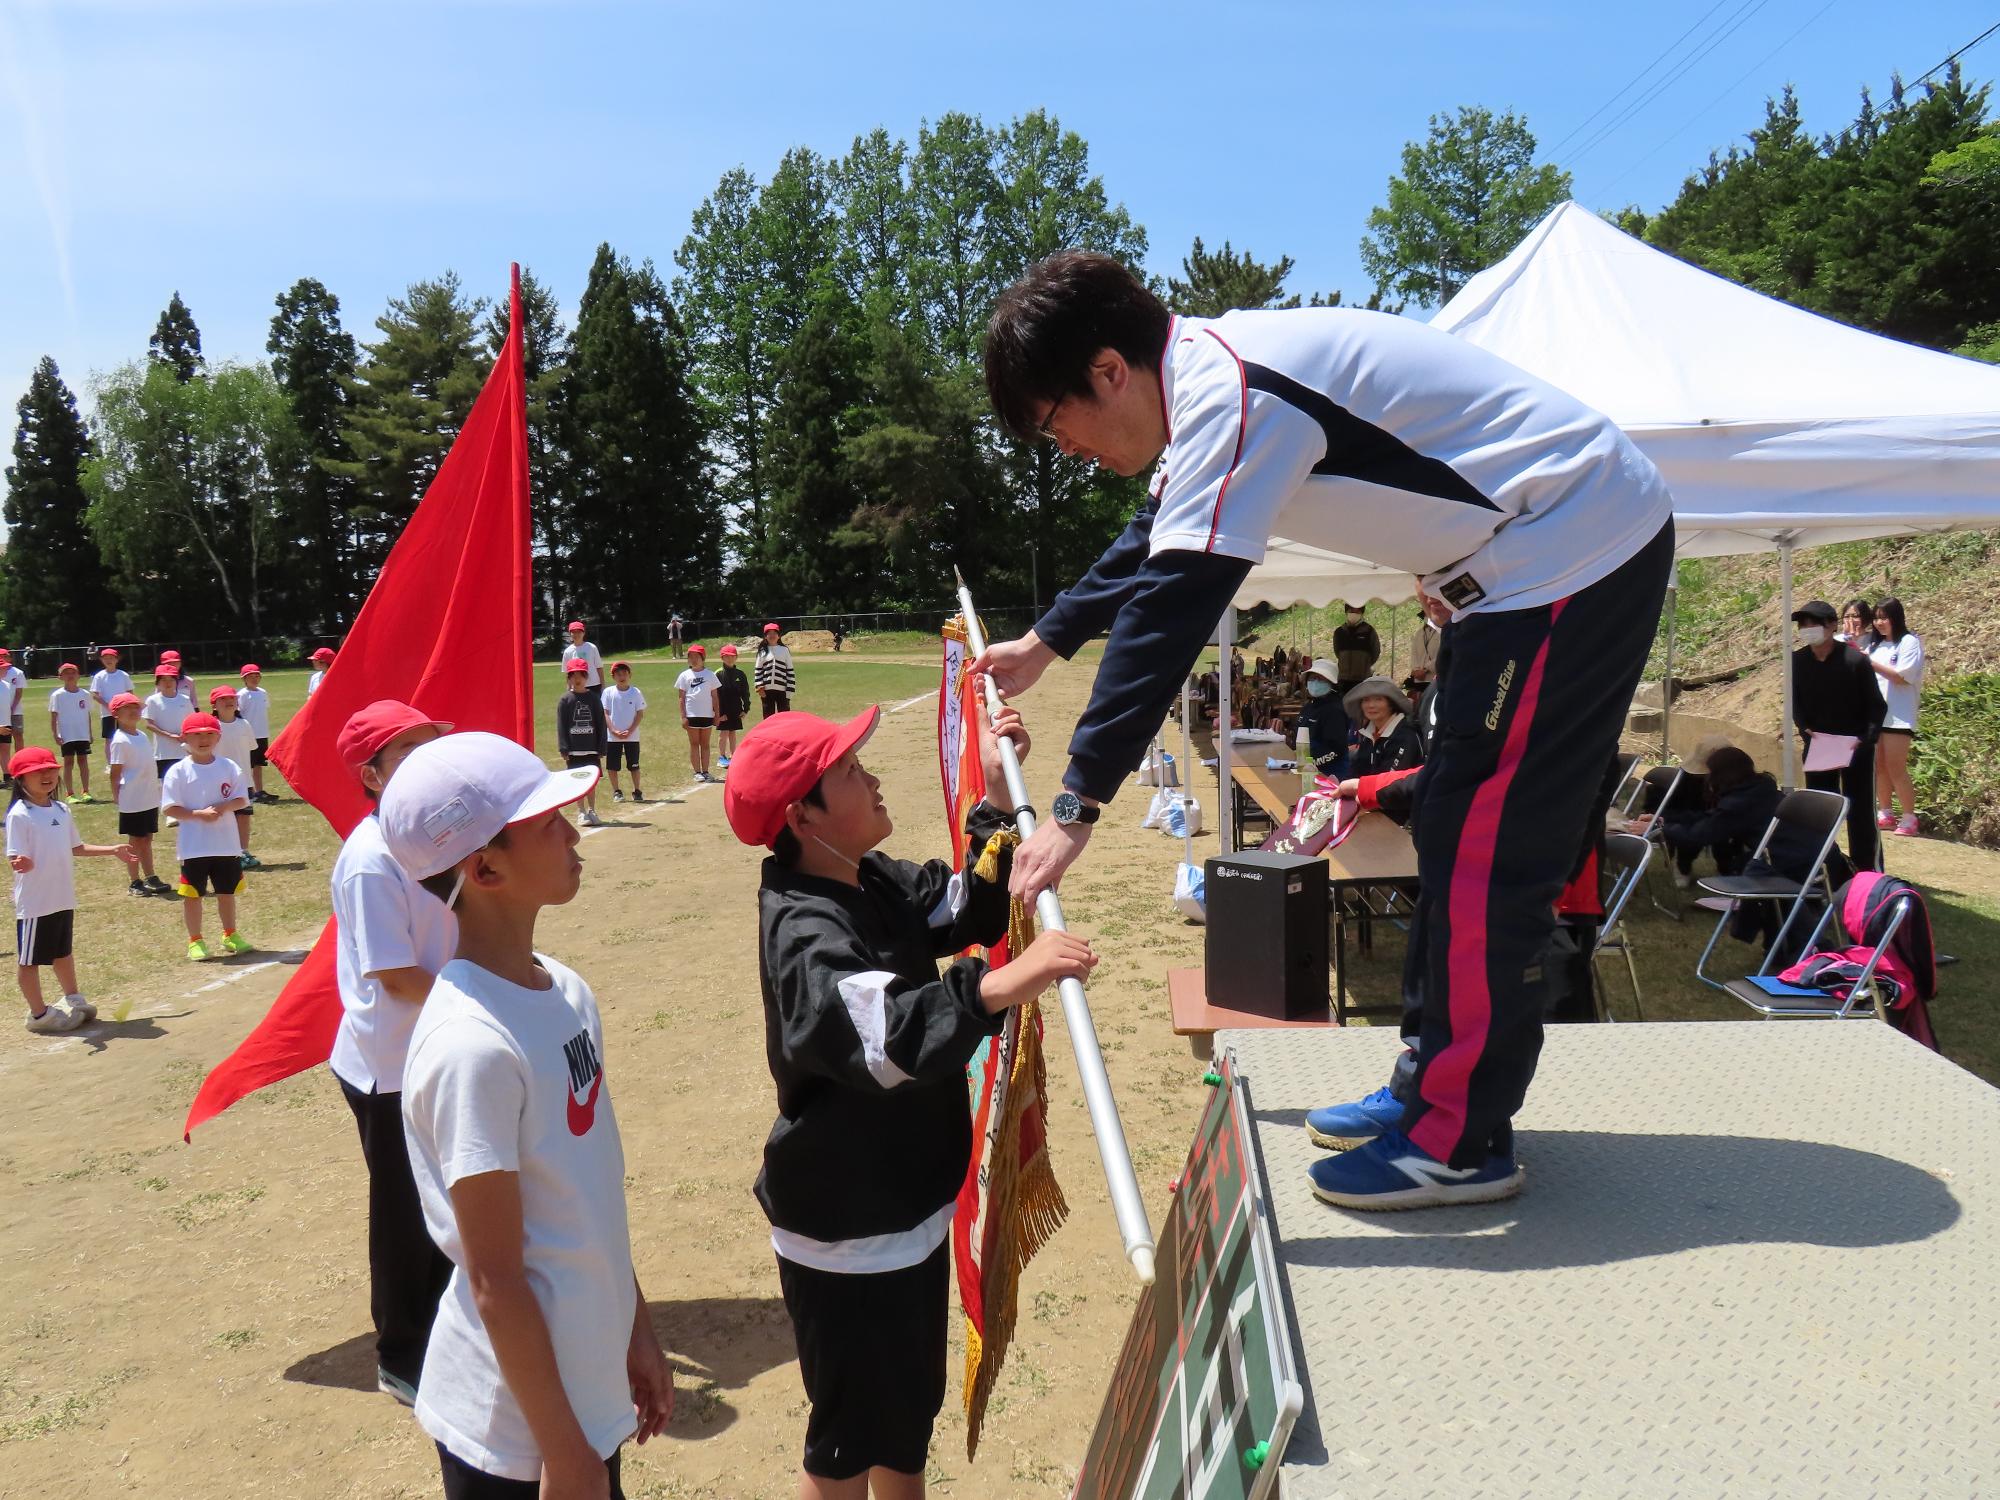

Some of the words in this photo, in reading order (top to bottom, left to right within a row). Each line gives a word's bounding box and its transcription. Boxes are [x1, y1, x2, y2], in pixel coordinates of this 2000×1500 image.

[1485, 687, 1507, 731] Global
[1498, 659, 1516, 691] Elite
[563, 1028, 601, 1093] NIKE
